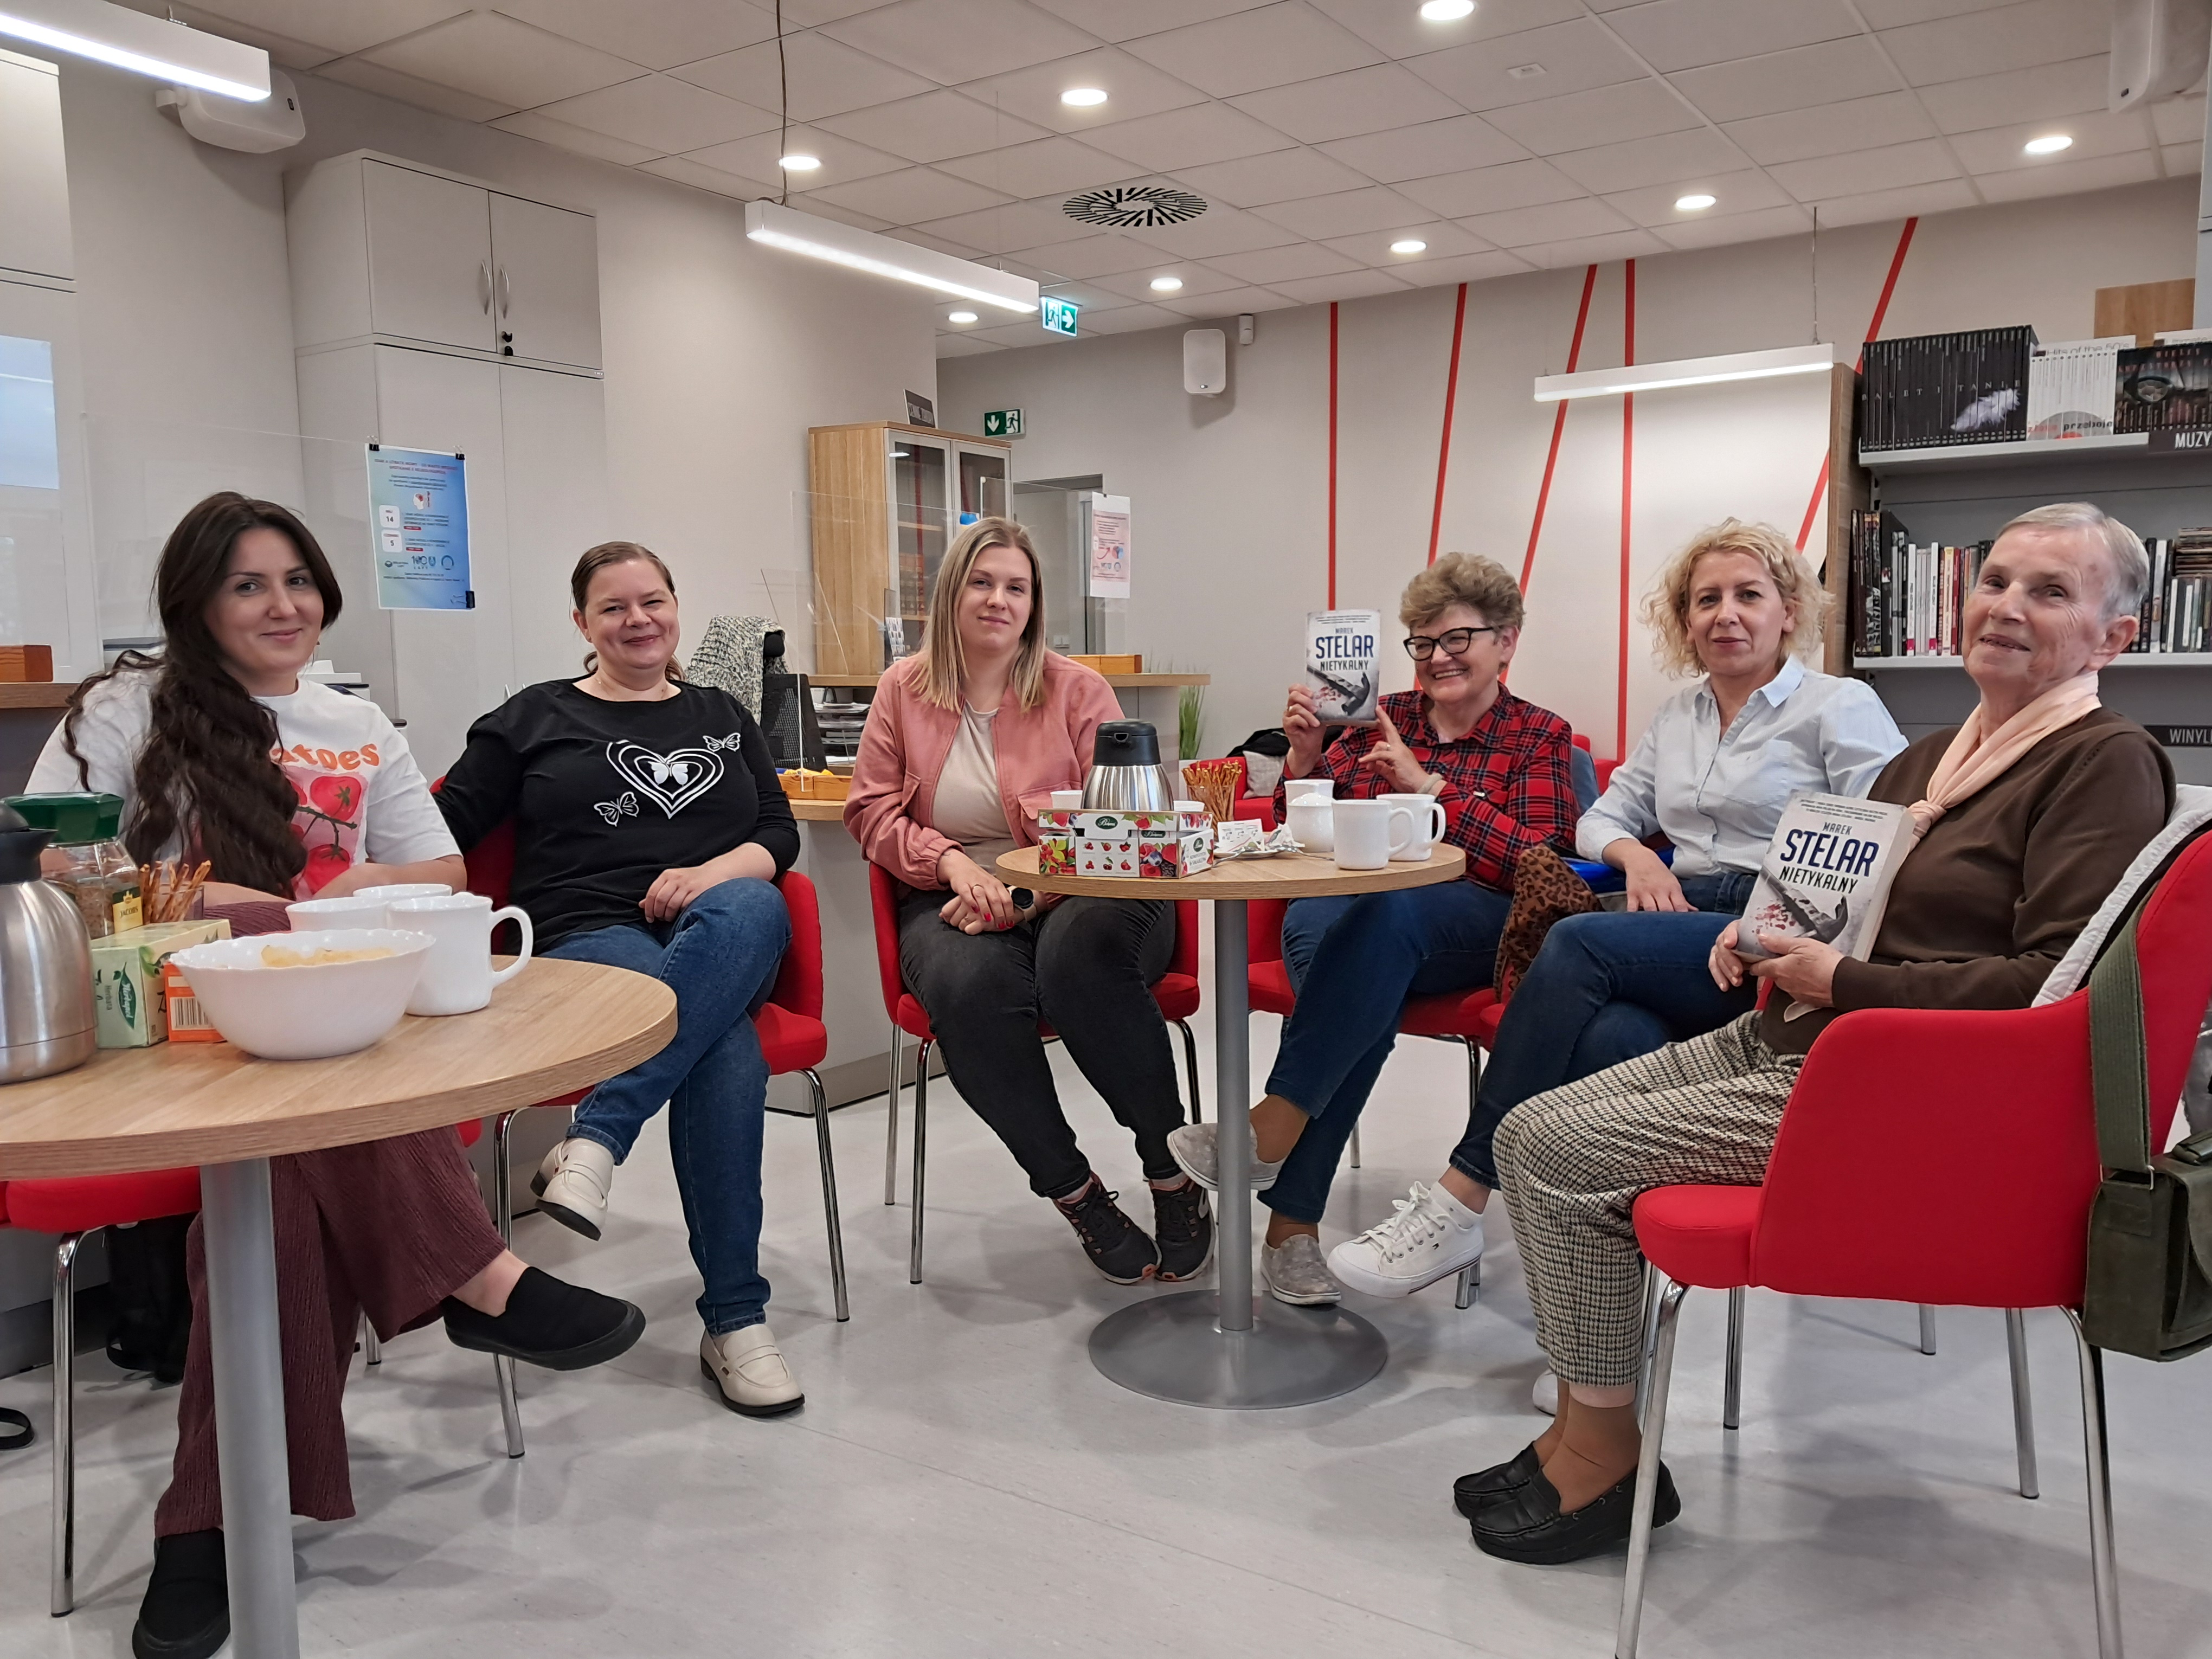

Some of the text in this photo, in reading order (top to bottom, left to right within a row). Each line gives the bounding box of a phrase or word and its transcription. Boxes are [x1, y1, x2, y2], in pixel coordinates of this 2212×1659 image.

[1315, 635, 1374, 659] STELAR
[1320, 659, 1369, 672] NIETYKALNY
[1822, 821, 1853, 835] MAREK
[1780, 828, 1880, 877] STELAR
[1778, 865, 1859, 894] NIETYKALNY
[104, 985, 113, 1011] Herbata
